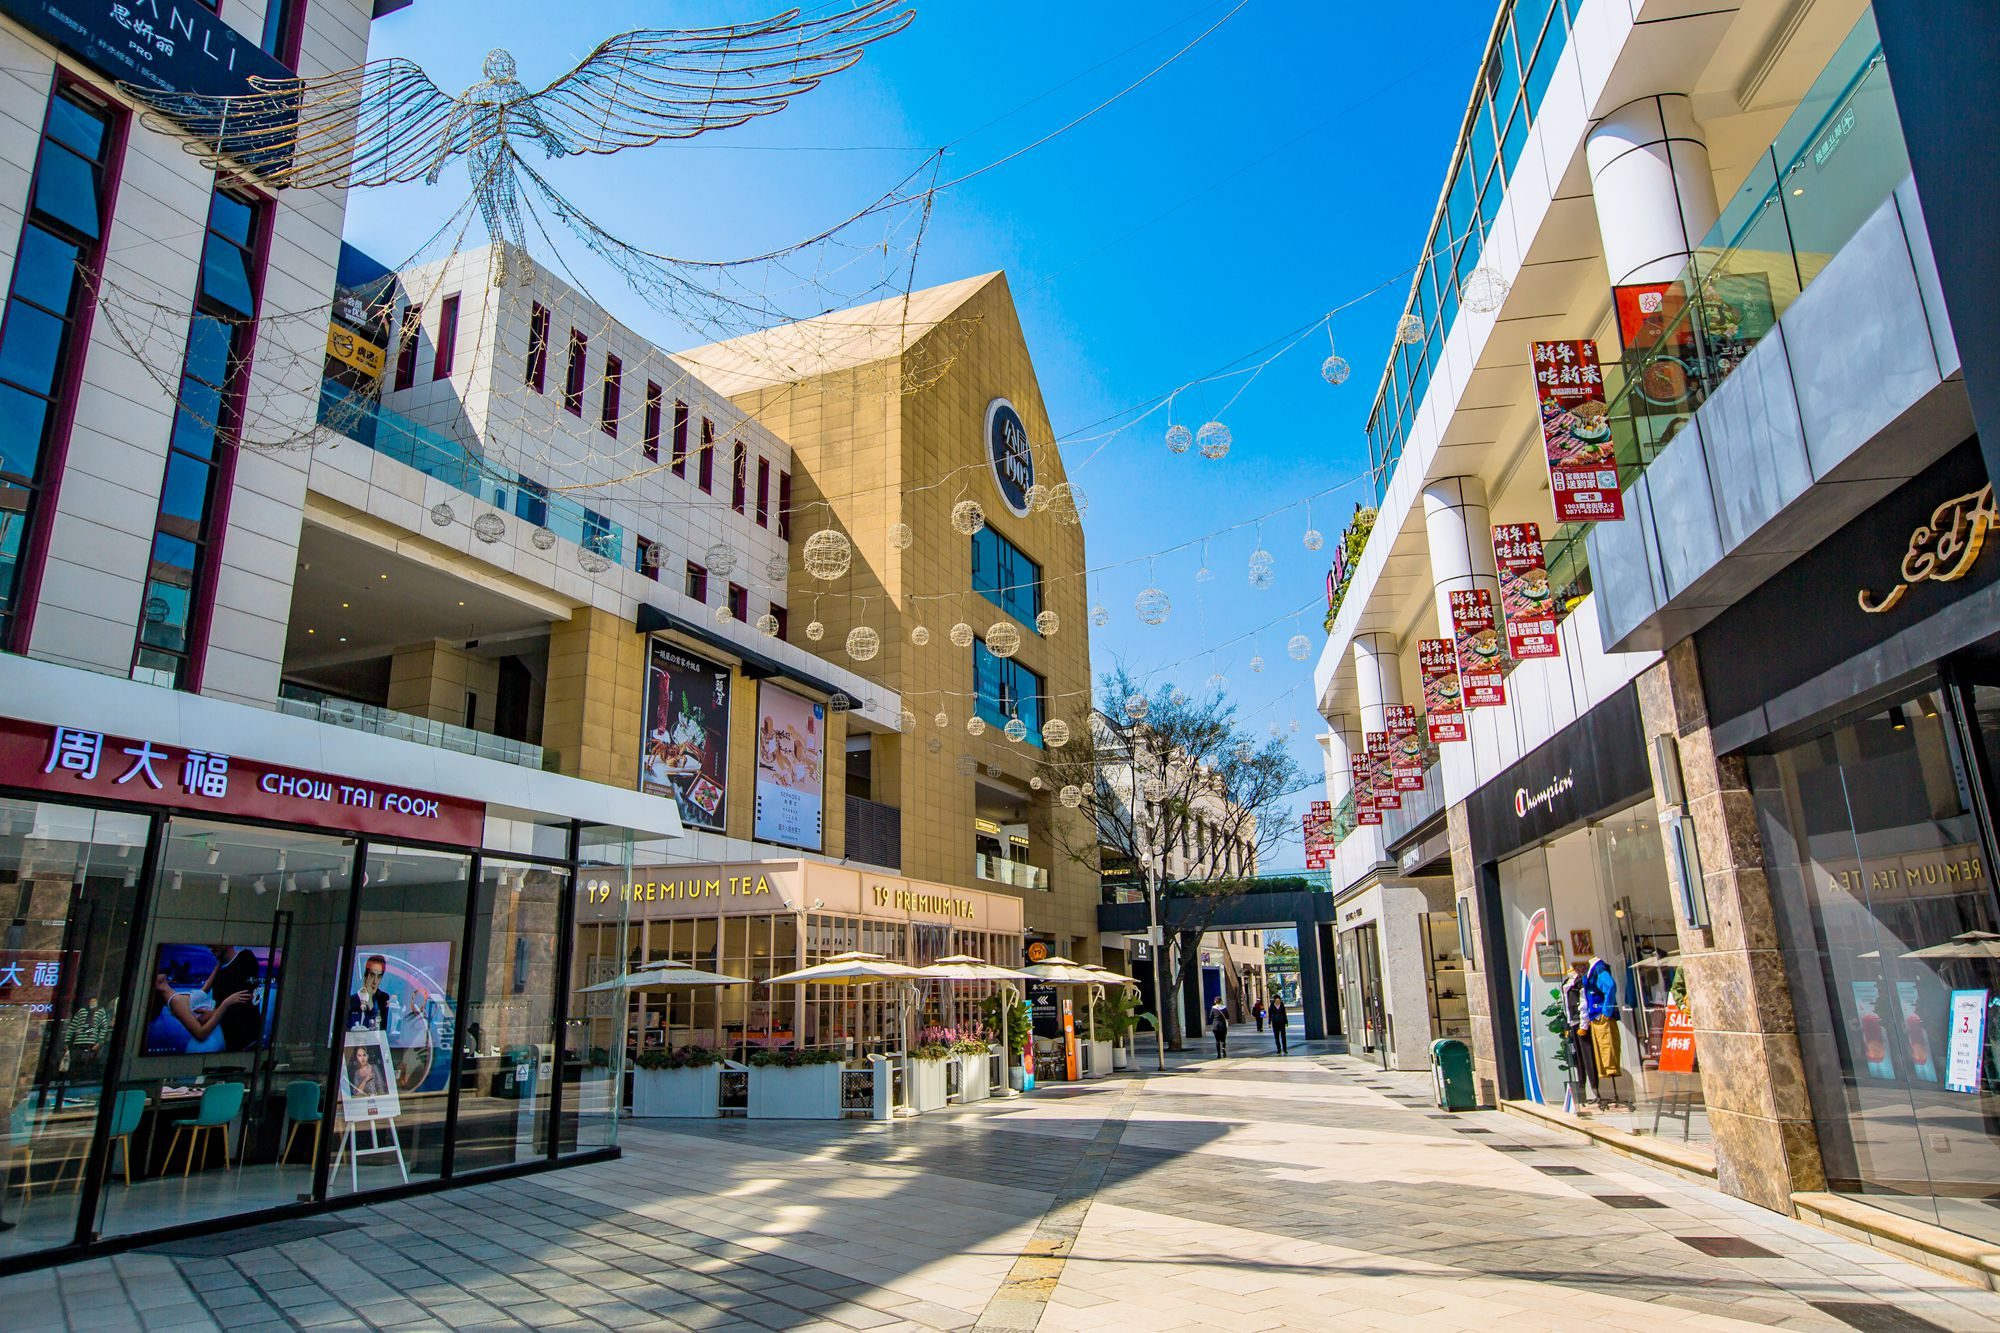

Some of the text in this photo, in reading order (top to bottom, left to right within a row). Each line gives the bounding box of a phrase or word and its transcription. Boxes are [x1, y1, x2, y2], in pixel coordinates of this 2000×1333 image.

[128, 40, 154, 61] PRO
[1536, 342, 1575, 363] 新年
[1538, 364, 1601, 385] 吃新菜
[1494, 525, 1524, 541] 新年
[1496, 541, 1543, 558] 吃新菜
[44, 725, 230, 799] 周大福
[262, 773, 440, 819] CHOW TAI FOOK
[1515, 773, 1574, 818] Champion
[587, 885, 611, 904] T9
[729, 875, 770, 896] TEA
[873, 886, 975, 919] T9 PREMIUM TEA
